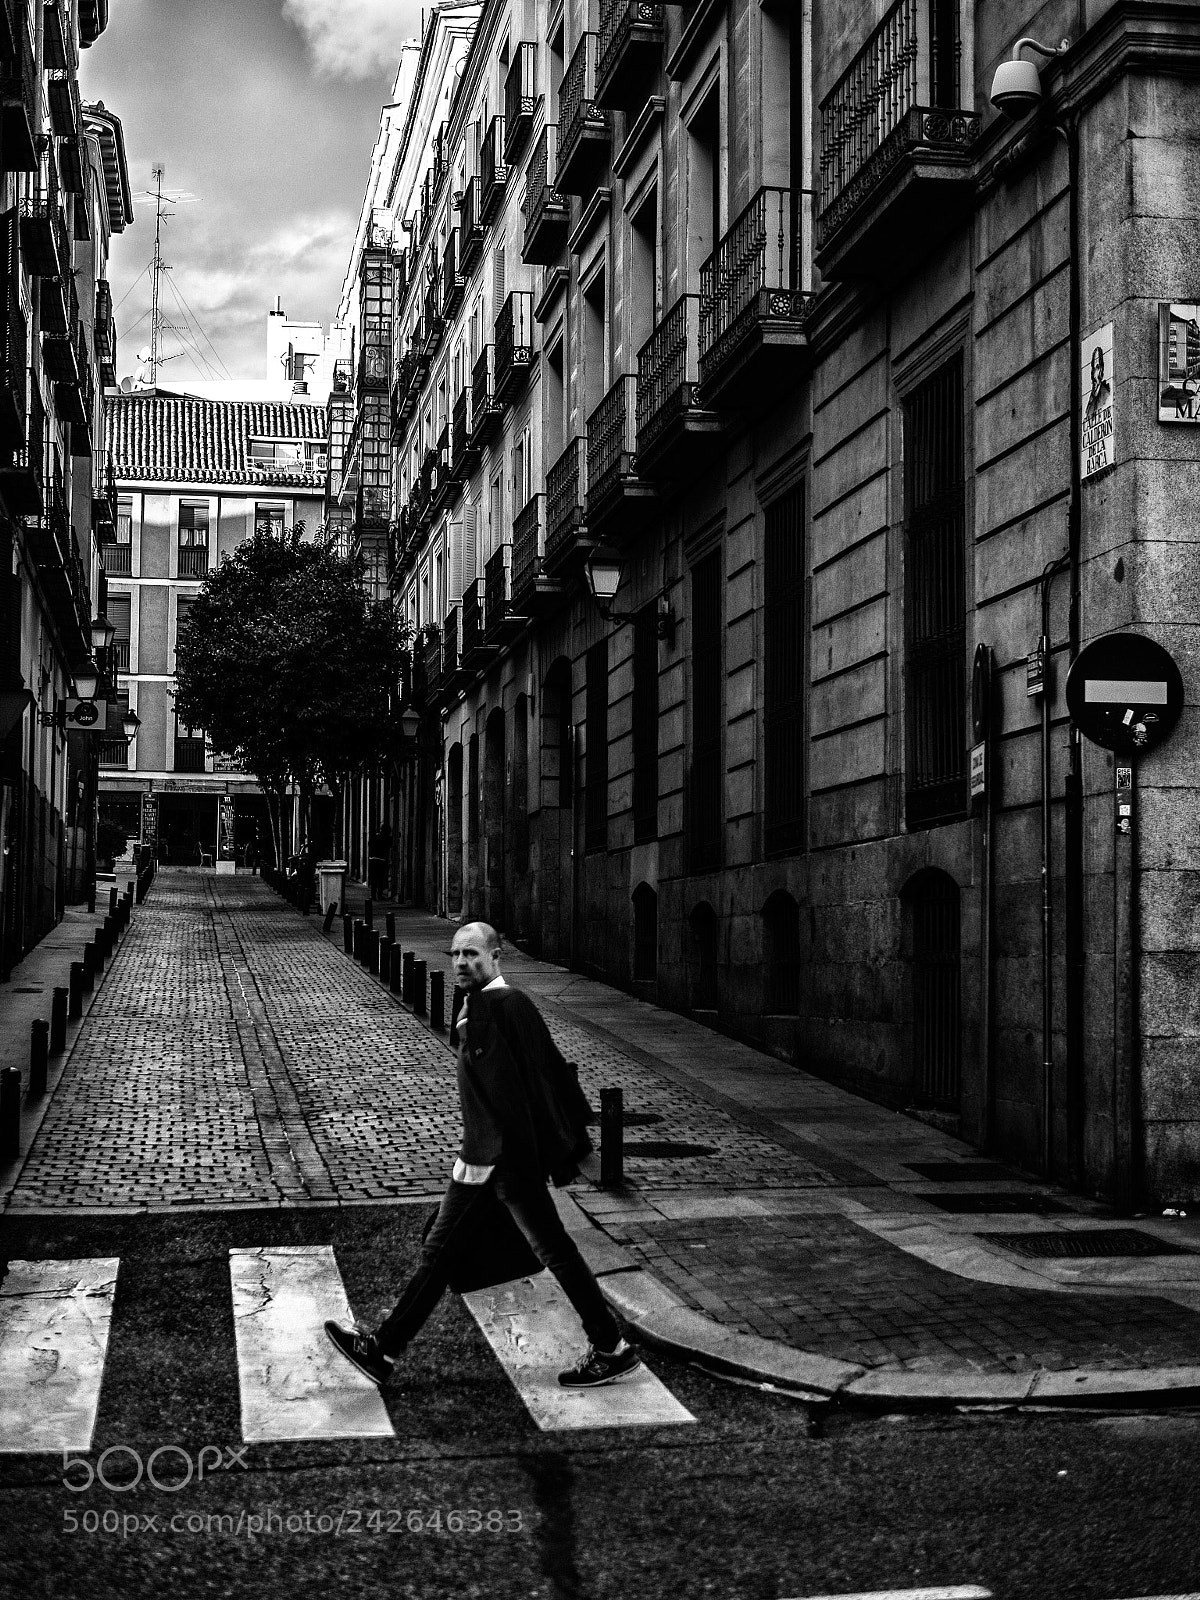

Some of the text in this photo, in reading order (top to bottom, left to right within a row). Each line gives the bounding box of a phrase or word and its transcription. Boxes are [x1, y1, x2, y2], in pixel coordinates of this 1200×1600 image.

[1089, 439, 1105, 458] DE LA
[1086, 450, 1107, 475] BARCA
